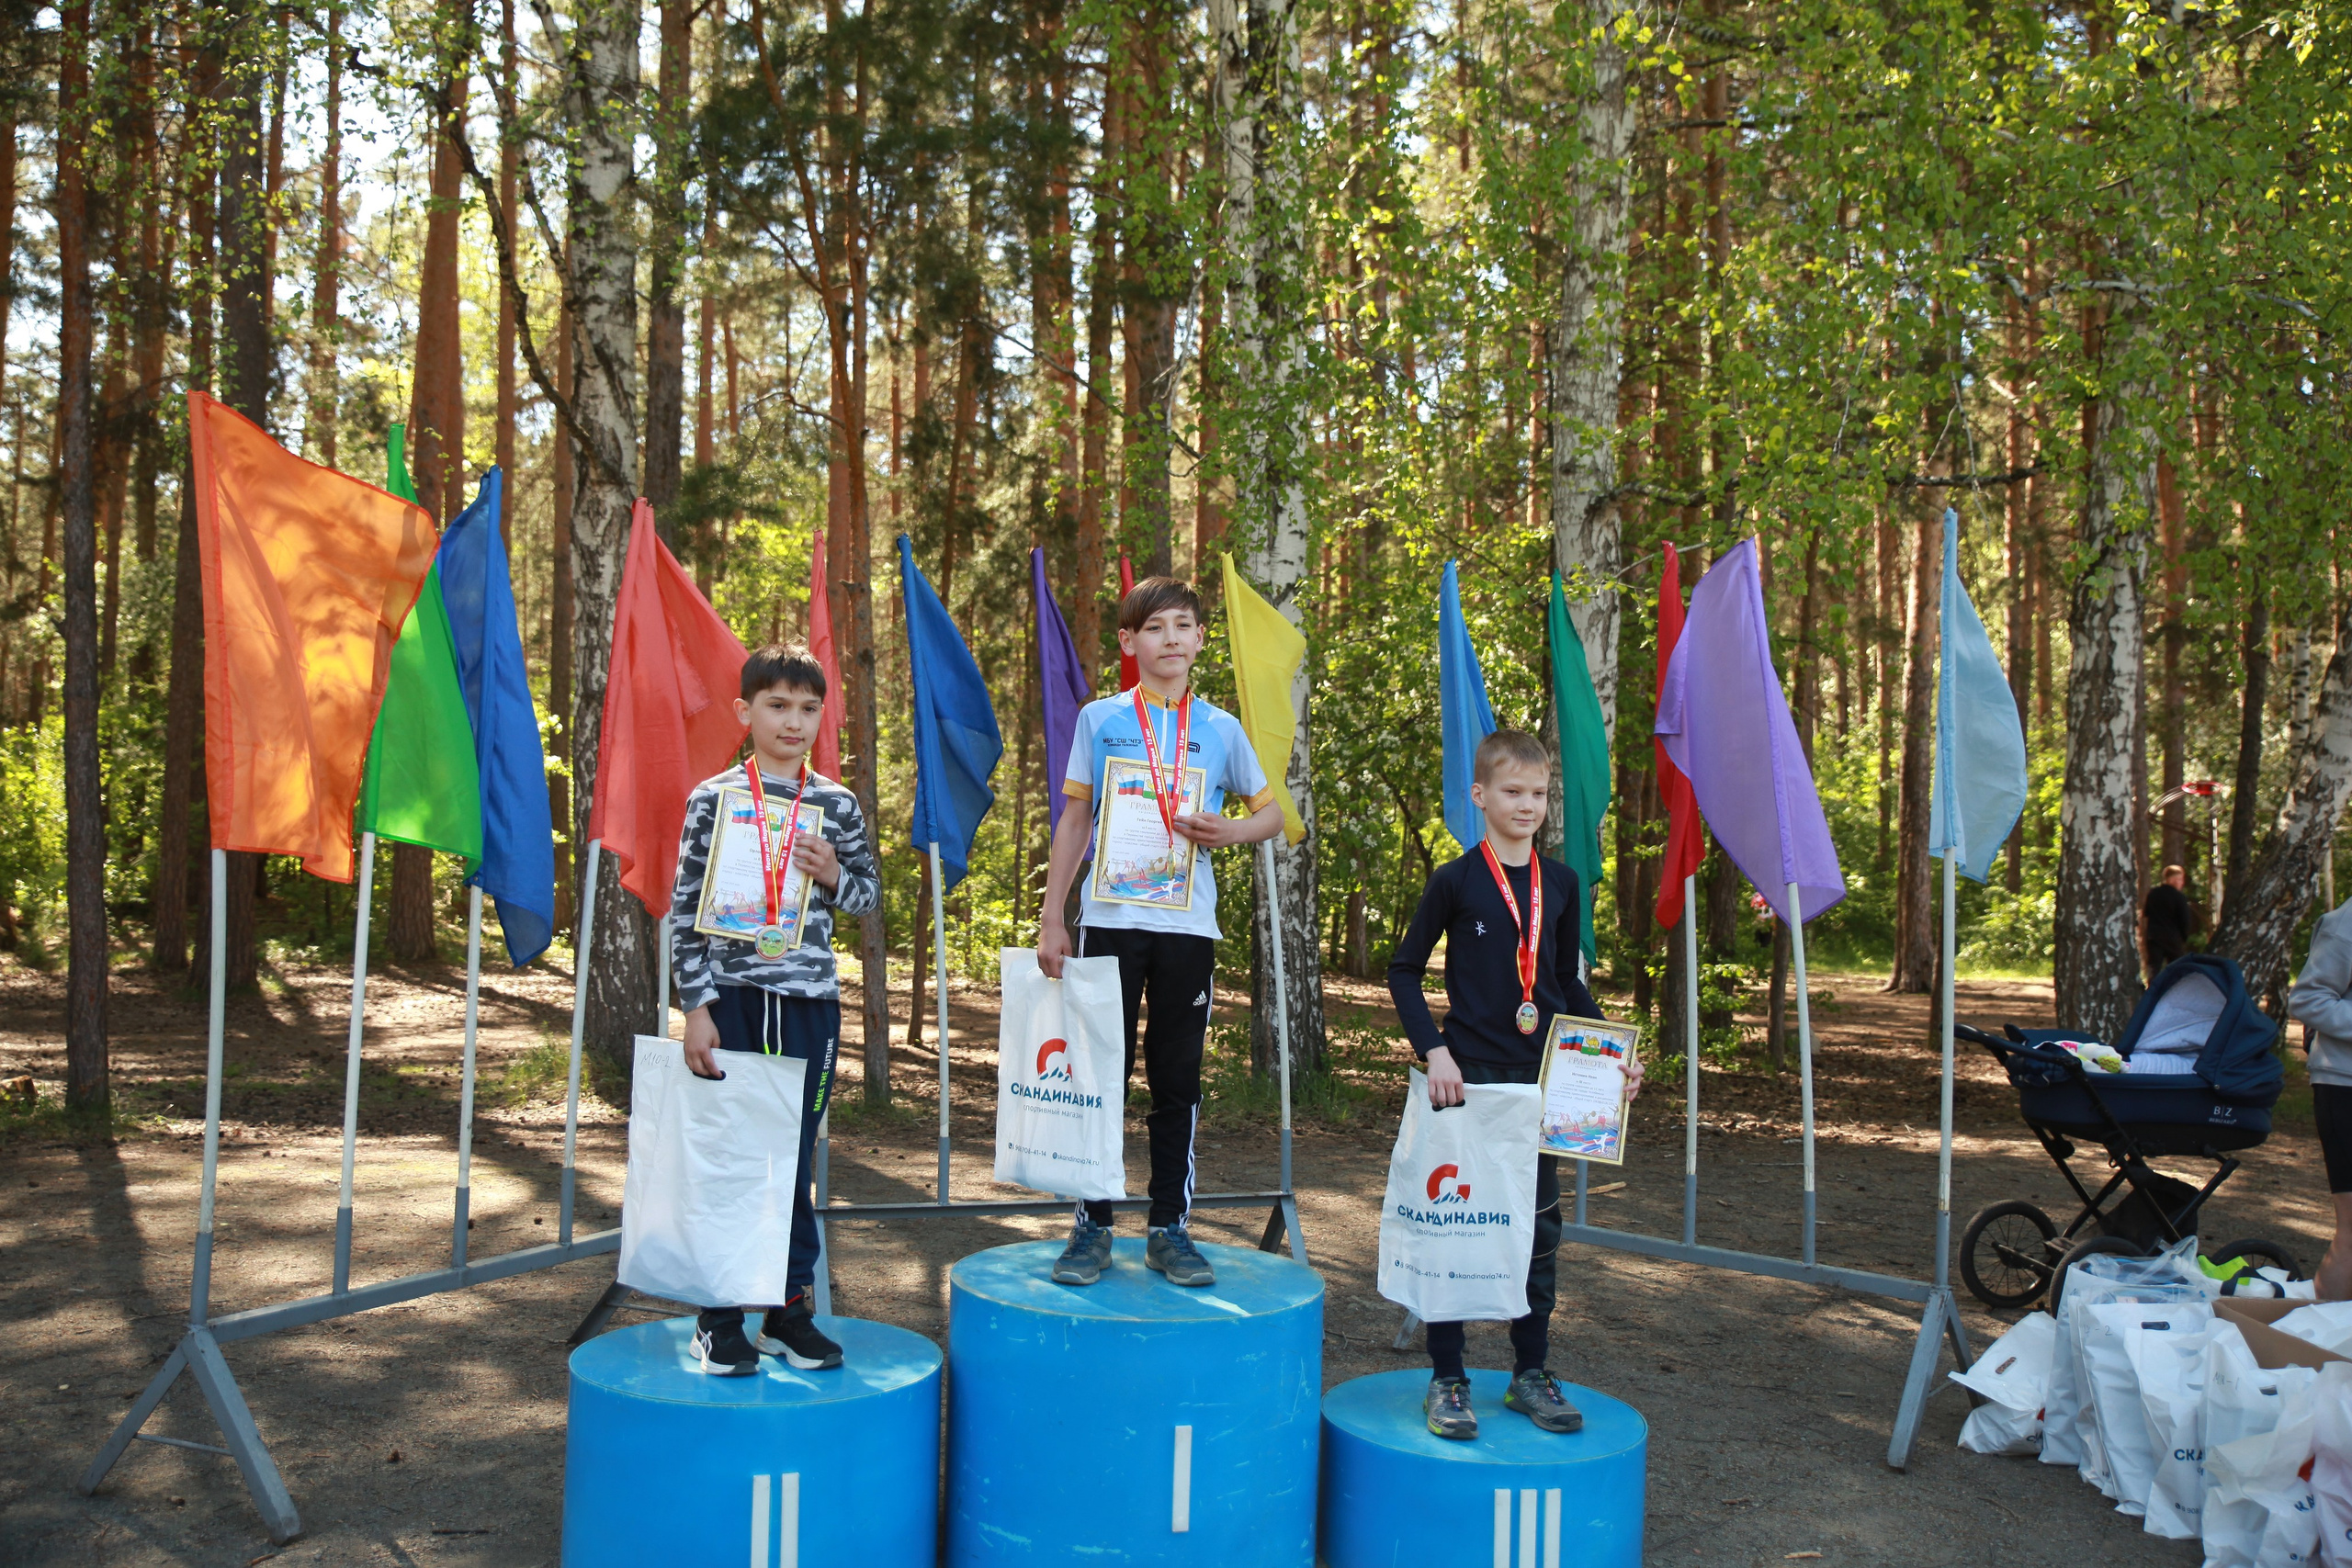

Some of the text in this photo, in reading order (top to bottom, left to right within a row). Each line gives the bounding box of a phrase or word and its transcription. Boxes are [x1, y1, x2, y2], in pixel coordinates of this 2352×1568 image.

[761, 821, 769, 843] Марья
[783, 824, 793, 847] Марья
[812, 1037, 834, 1111] MAKE THE FUTURE
[1567, 1056, 1608, 1069] ГРАМОТА
[1011, 1082, 1102, 1109] СКАНДИНАВИЯ
[1397, 1203, 1510, 1227] СКАНДИНАВИЯ
